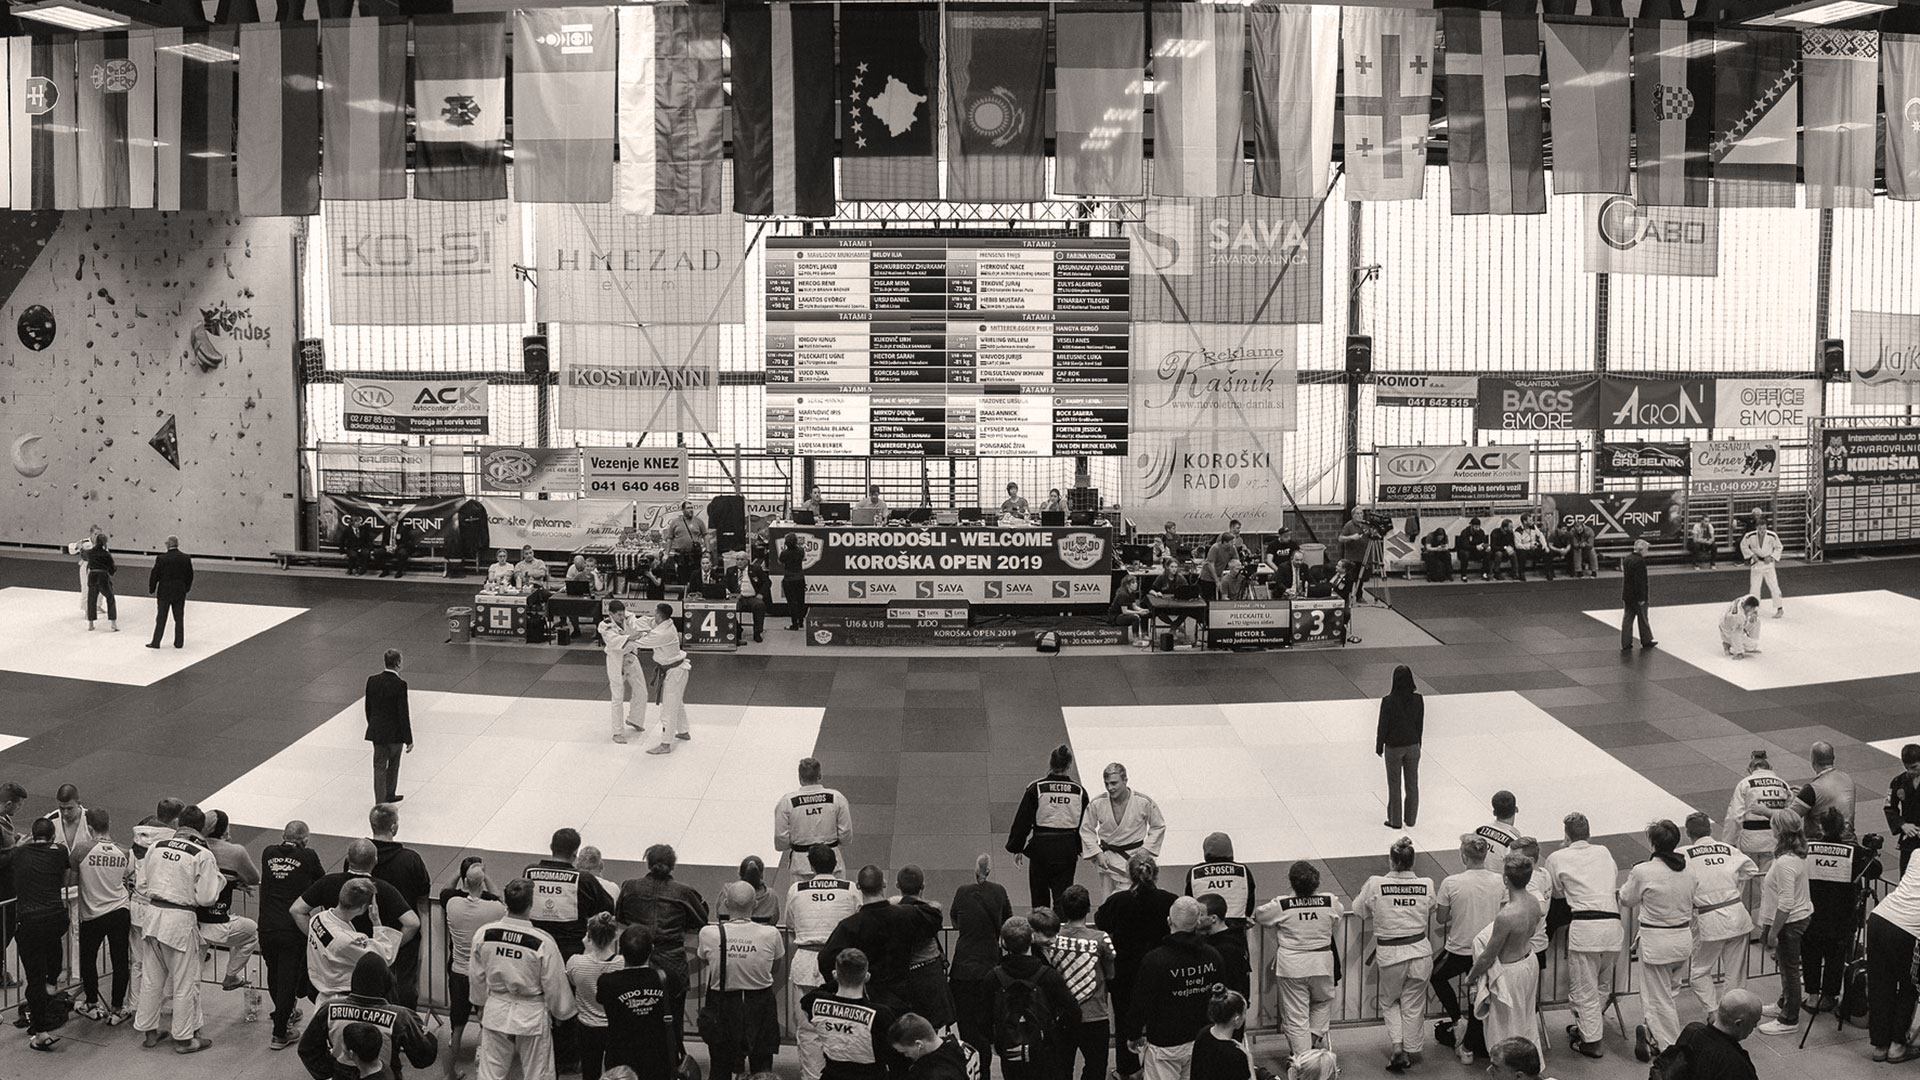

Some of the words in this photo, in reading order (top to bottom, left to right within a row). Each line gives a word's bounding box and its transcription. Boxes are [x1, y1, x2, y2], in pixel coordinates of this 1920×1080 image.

[1210, 218, 1308, 250] SAVA
[340, 231, 491, 267] KO-SI
[557, 249, 721, 272] HMEZAD
[1210, 254, 1308, 265] ZAVAROVALNICA
[1203, 347, 1284, 363] Reklame
[574, 368, 705, 388] KOSTMANN
[1377, 375, 1428, 388] KOMOT
[1515, 379, 1559, 388] GALANTERIJA
[358, 390, 388, 404] KIA
[413, 387, 480, 404] ACK
[1503, 390, 1574, 413] BAGS
[1740, 387, 1804, 406] OFFICE
[411, 404, 449, 412] Avtocenter
[450, 403, 481, 411] Koroška
[1407, 398, 1427, 407] 041
[1428, 398, 1448, 407] 642
[1450, 398, 1470, 407] 515
[410, 418, 435, 427] Prodaja
[436, 418, 443, 426] in
[444, 418, 463, 426] servis
[1502, 412, 1574, 430] &MORE
[1740, 409, 1803, 426] &MORE
[1847, 433, 1898, 443] International
[1184, 450, 1270, 468] KOROŠKI
[1613, 450, 1640, 459] Avto
[591, 456, 639, 472] Vezenje
[643, 456, 679, 470] KNEZ
[1396, 459, 1429, 472] KIA
[1456, 452, 1521, 470] ACK
[1612, 457, 1682, 467] GRUBELNIK
[1846, 454, 1919, 472] KOROŠKA
[591, 481, 617, 492] 041
[621, 481, 649, 492] 640
[652, 481, 680, 492] 468
[1183, 473, 1240, 489] RADIO
[1720, 482, 1740, 491] 040
[1740, 481, 1759, 491] 699
[1760, 480, 1778, 490] 225
[1386, 486, 1396, 494] 02
[1423, 485, 1437, 493] 850
[1451, 484, 1477, 493] Prodaja
[1485, 484, 1505, 492] servis
[1505, 484, 1522, 492] vozil
[532, 516, 572, 529] pekarne
[1622, 510, 1662, 527] PRINT
[403, 517, 444, 533] PRINT
[829, 527, 947, 547] DOBRODOŠLI
[959, 532, 1053, 547] WELCOME
[844, 550, 935, 570] KOROŠKA
[940, 555, 991, 570] OPEN
[997, 555, 1043, 570] 2019
[869, 584, 897, 594] SAVA
[937, 584, 964, 594] SAVA
[1005, 583, 1033, 593] SAVA
[1073, 583, 1100, 592] SAVA
[700, 611, 718, 638] 4
[846, 620, 861, 628] U16
[869, 620, 885, 628] U18
[916, 620, 938, 628] JUDO
[1309, 610, 1325, 636] 3
[934, 629, 972, 637] KOROŠKA
[973, 629, 997, 637] OPEN
[997, 629, 1017, 637] 2019
[1049, 783, 1072, 793] HECTOR
[1049, 796, 1071, 805] NED
[806, 807, 823, 816] LAT
[88, 854, 127, 868] SERBIA
[162, 851, 181, 862] SLO
[1704, 857, 1725, 866] SLO
[1815, 858, 1838, 868] KAZ
[530, 870, 574, 882] MAGOMADOV
[1203, 865, 1235, 876] S.POSCH
[538, 885, 562, 895] RUS
[1207, 879, 1233, 890] AUT
[811, 893, 836, 902] SLO
[1392, 898, 1417, 907] NED
[1298, 912, 1319, 921] ITA
[501, 931, 522, 945] KUIN
[1052, 934, 1098, 953] HITE
[495, 946, 523, 960] NED
[617, 989, 641, 1004] JUDO
[331, 1006, 360, 1021] BRUNO
[361, 1010, 393, 1026] CAPAN
[832, 1004, 870, 1025] MARUSKA
[824, 1021, 853, 1034] SVK
